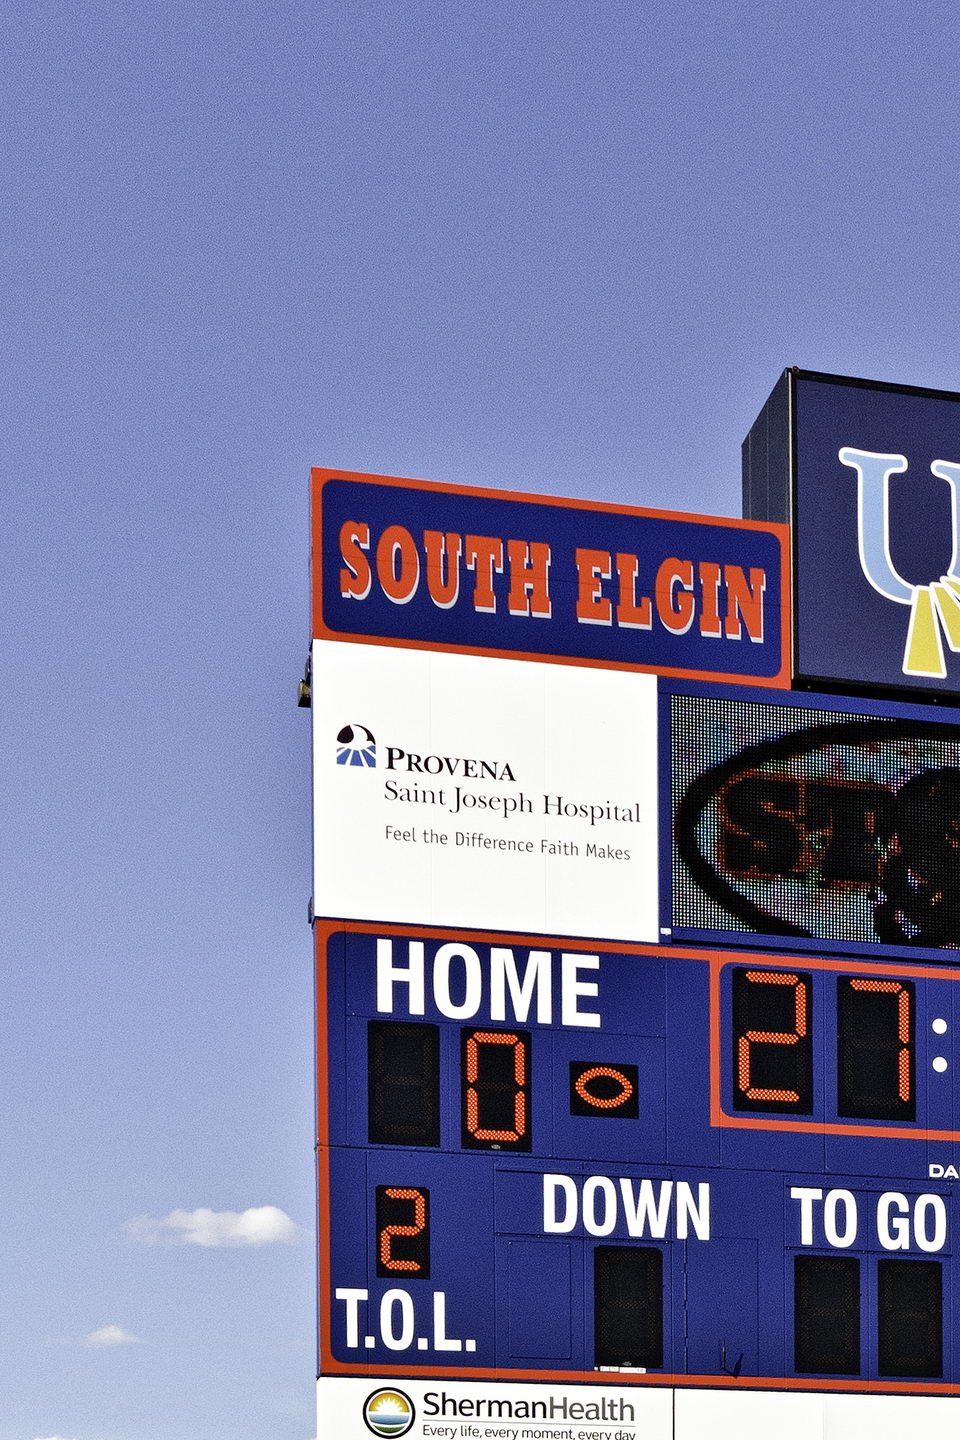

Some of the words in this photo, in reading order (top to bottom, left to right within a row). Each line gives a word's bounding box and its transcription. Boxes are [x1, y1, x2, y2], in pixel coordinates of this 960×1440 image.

[338, 520, 553, 619] SOUTH
[575, 547, 766, 643] ELGIN
[384, 746, 517, 782] PROVENA
[384, 779, 447, 806] Saint
[449, 786, 534, 818] Joseph
[542, 794, 641, 826] Hospital
[384, 825, 417, 843] Feel
[422, 828, 449, 846] the
[455, 831, 534, 854] Difference
[540, 839, 579, 857] Faith
[586, 843, 631, 861] Makes
[375, 938, 602, 1029] HOME
[466, 1031, 526, 1142] 0
[379, 1188, 427, 1272] 2
[542, 1173, 711, 1241] DOWN
[790, 1186, 859, 1250] TO
[875, 1192, 947, 1253] GO
[334, 1287, 478, 1353] T.O.L.
[422, 1391, 636, 1422] ShermanHealth
[422, 1424, 458, 1440] Every
[460, 1424, 483, 1439] life,
